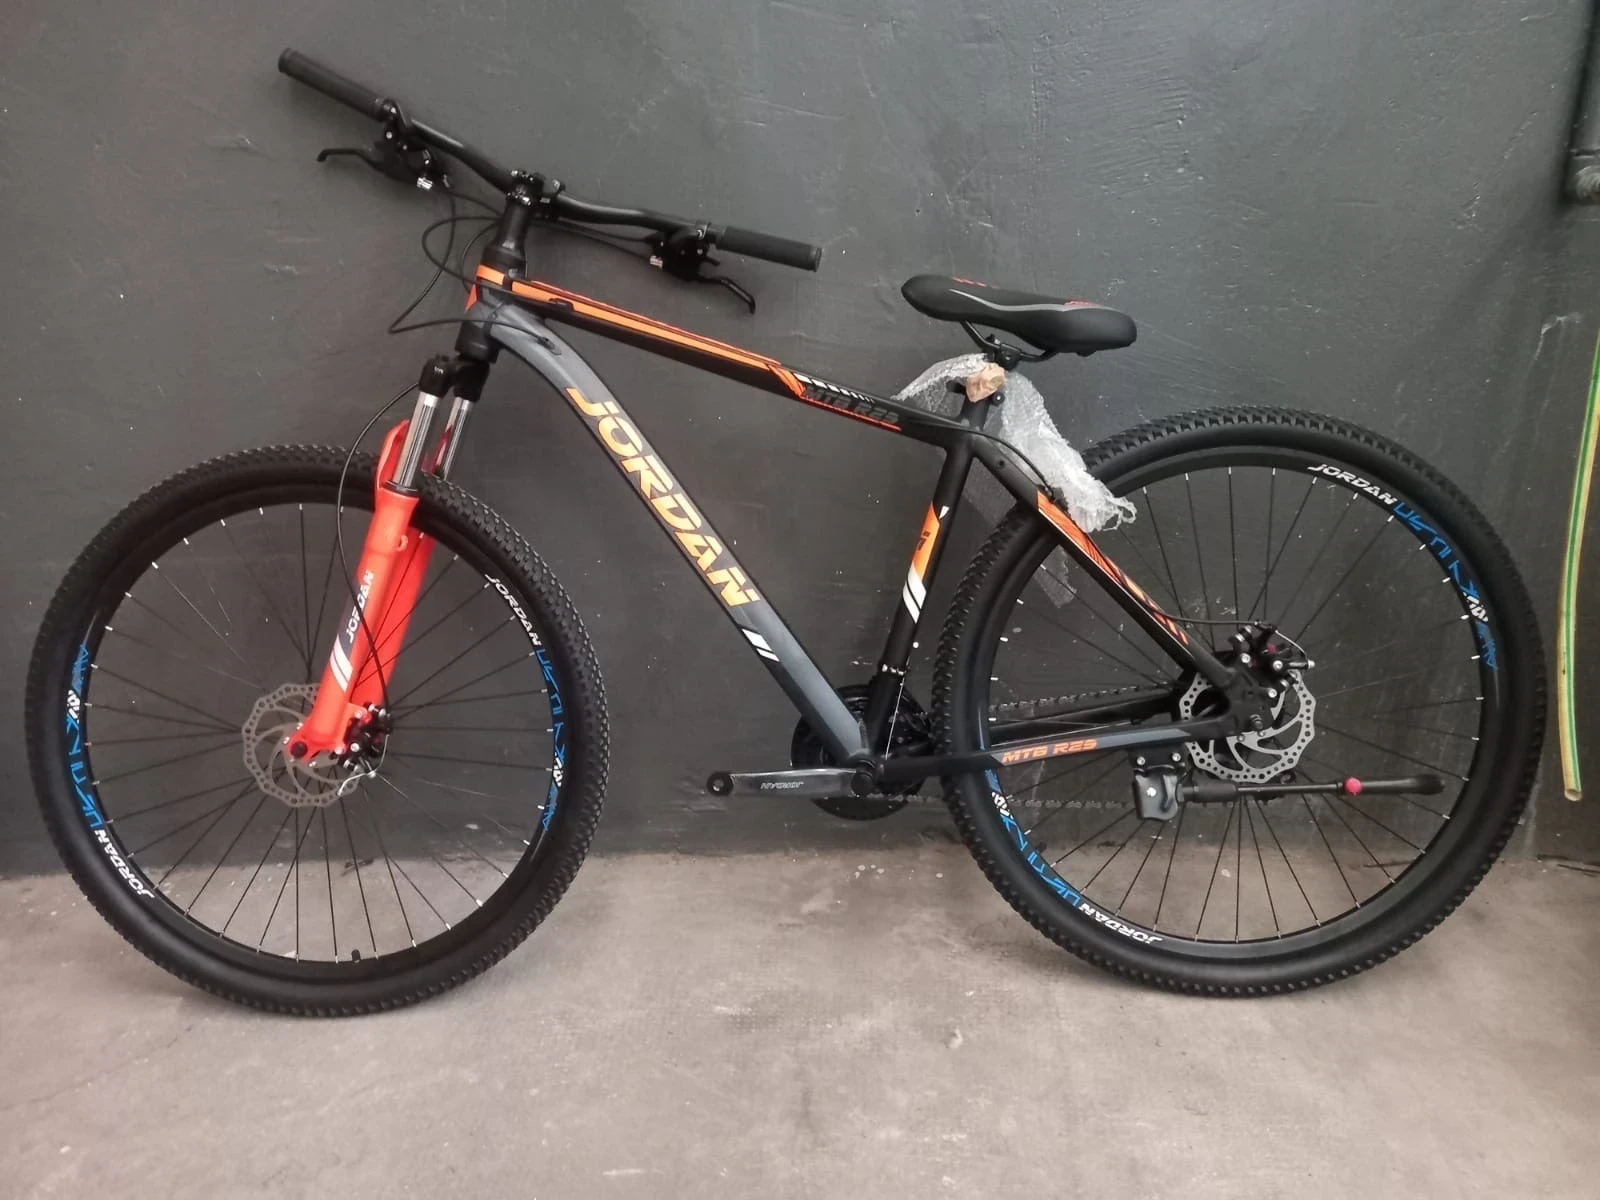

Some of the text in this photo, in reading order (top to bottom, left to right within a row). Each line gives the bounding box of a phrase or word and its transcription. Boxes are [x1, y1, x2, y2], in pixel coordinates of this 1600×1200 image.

[565, 387, 761, 607] JORDAN
[1307, 463, 1399, 505] JORDAN
[484, 574, 541, 646] JORDAN
[1001, 746, 1048, 763] MTB
[94, 829, 155, 899] JORDAN
[1079, 902, 1163, 945] JORDAN
